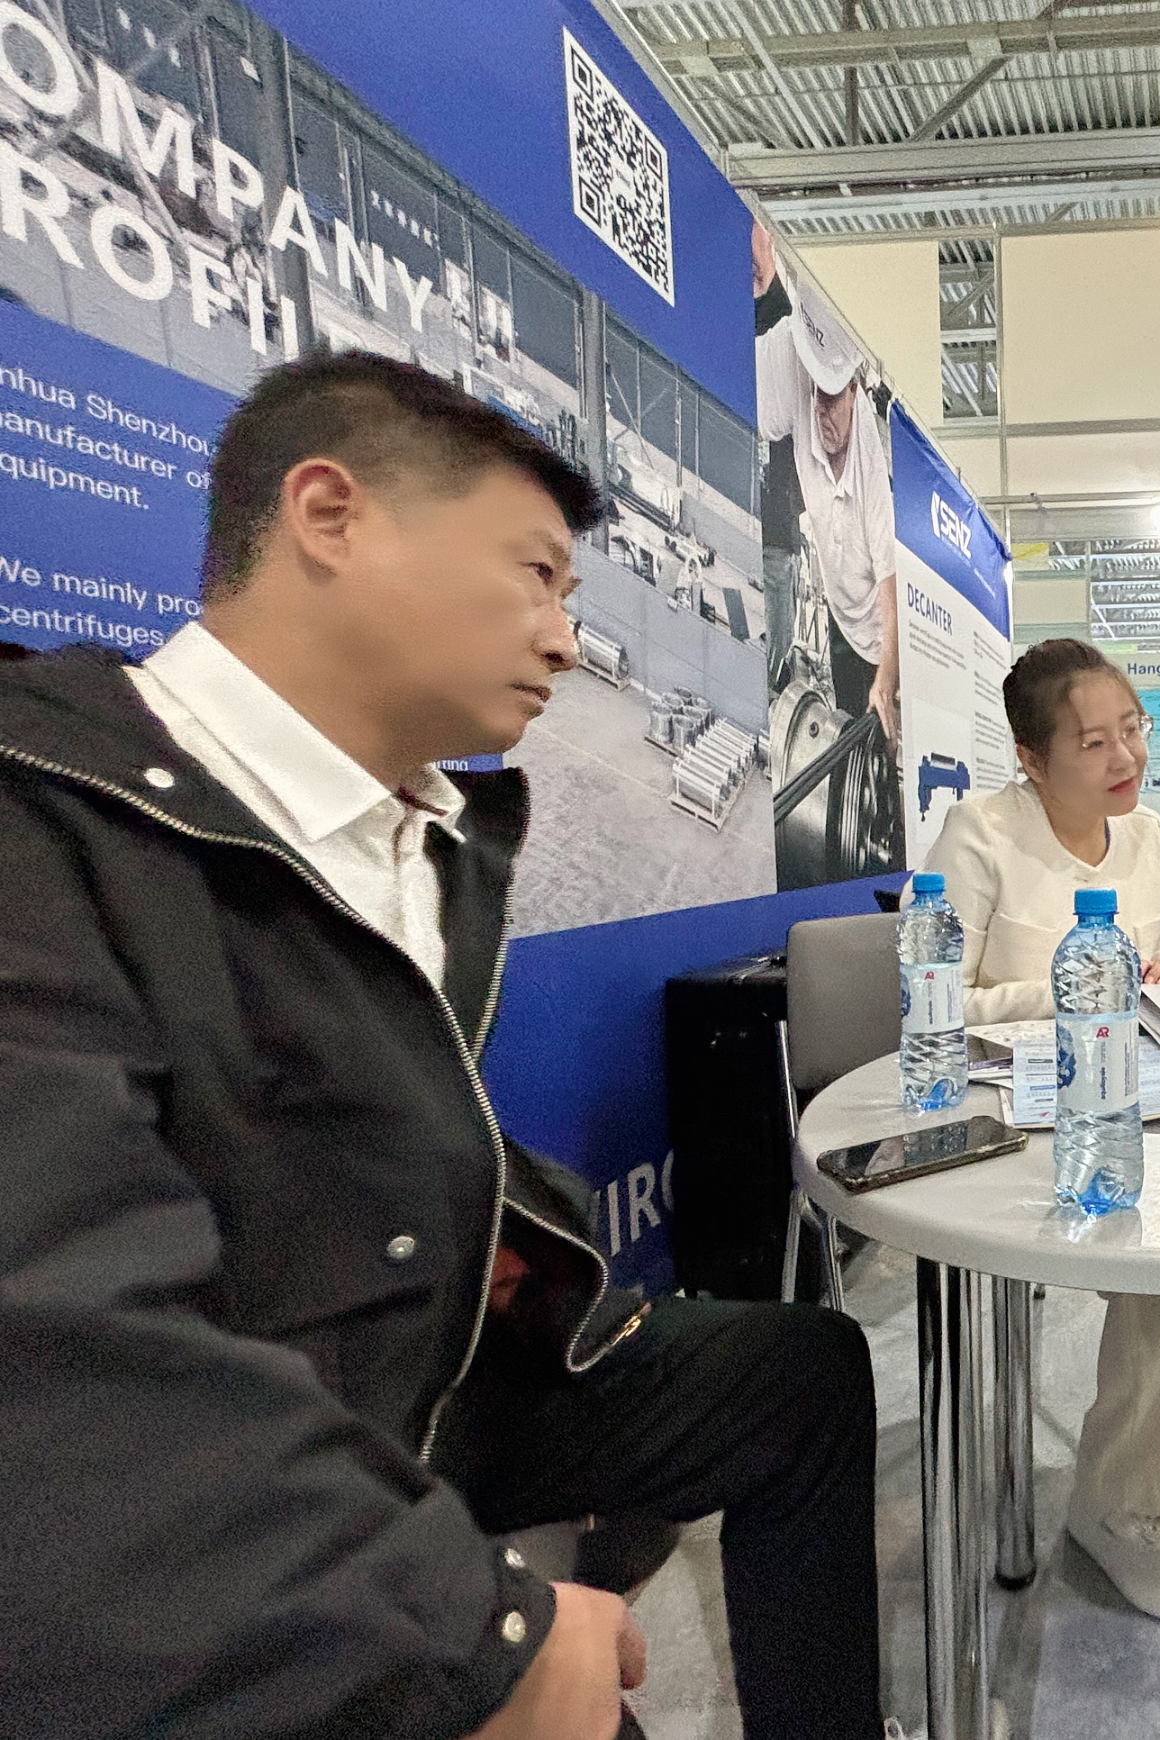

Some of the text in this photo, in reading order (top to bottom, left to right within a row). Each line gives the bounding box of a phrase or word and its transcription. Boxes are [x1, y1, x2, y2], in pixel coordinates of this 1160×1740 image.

[0, 137, 362, 362] ROFI
[0, 411, 177, 480] anufacturer
[53, 572, 147, 611] mainly
[157, 593, 204, 617] pro
[907, 582, 953, 636] DECANTER
[0, 603, 165, 648] centrifuges
